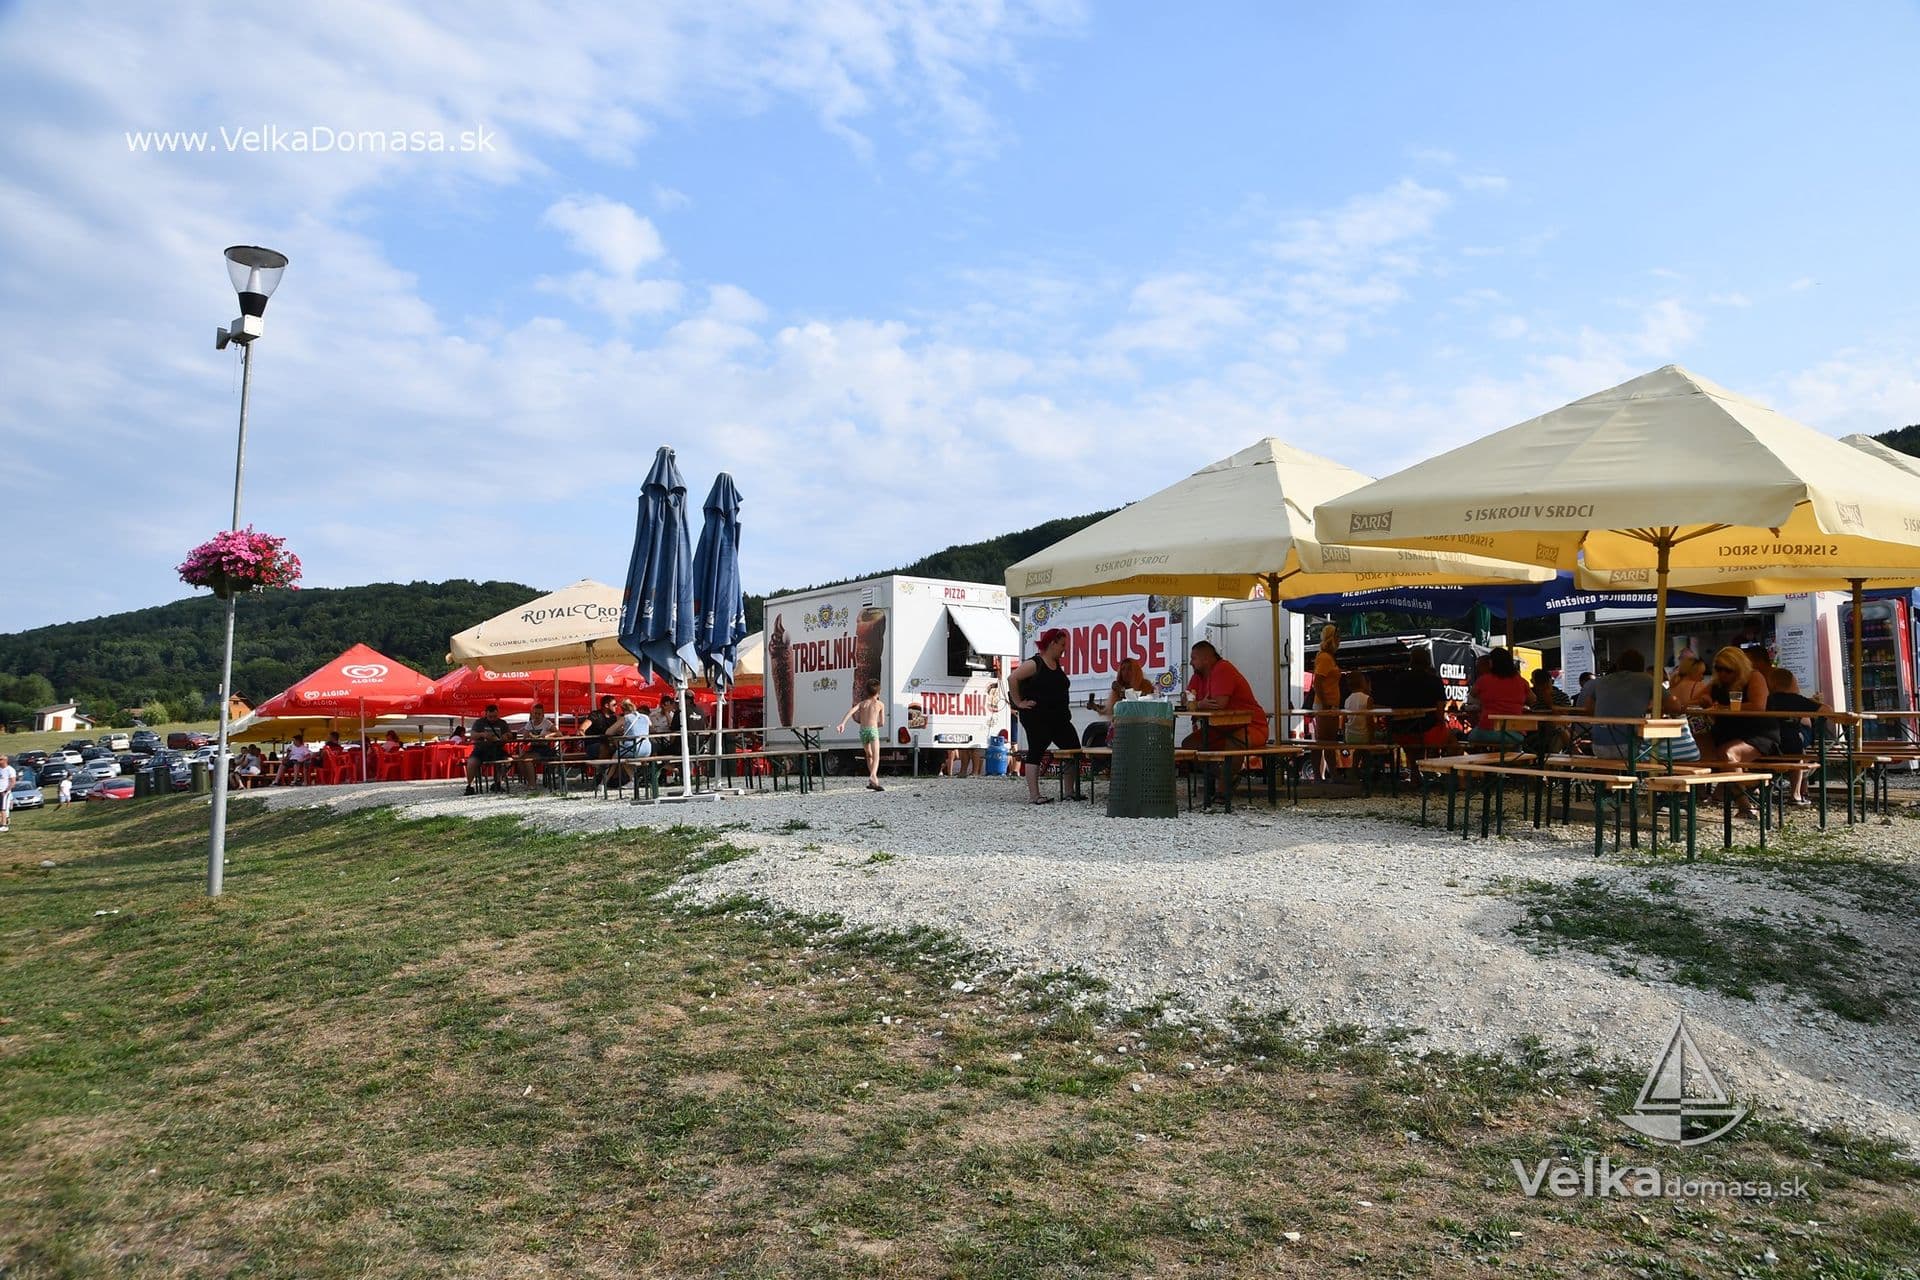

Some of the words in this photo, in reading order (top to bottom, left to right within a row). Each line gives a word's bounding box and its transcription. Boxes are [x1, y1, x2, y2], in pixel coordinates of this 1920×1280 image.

[1464, 510, 1473, 521] S
[1475, 506, 1531, 521] ISKROU
[1534, 506, 1544, 518] V
[1545, 505, 1594, 518] SRDCI
[944, 587, 966, 600] PIZZA
[521, 607, 574, 624] ROYAL
[792, 632, 857, 674] TRDELNÍK
[502, 671, 530, 679] ALGIDA
[1440, 663, 1466, 679] GRILL
[321, 689, 350, 697] ALGIDA
[920, 690, 987, 716] TRDELNÍK
